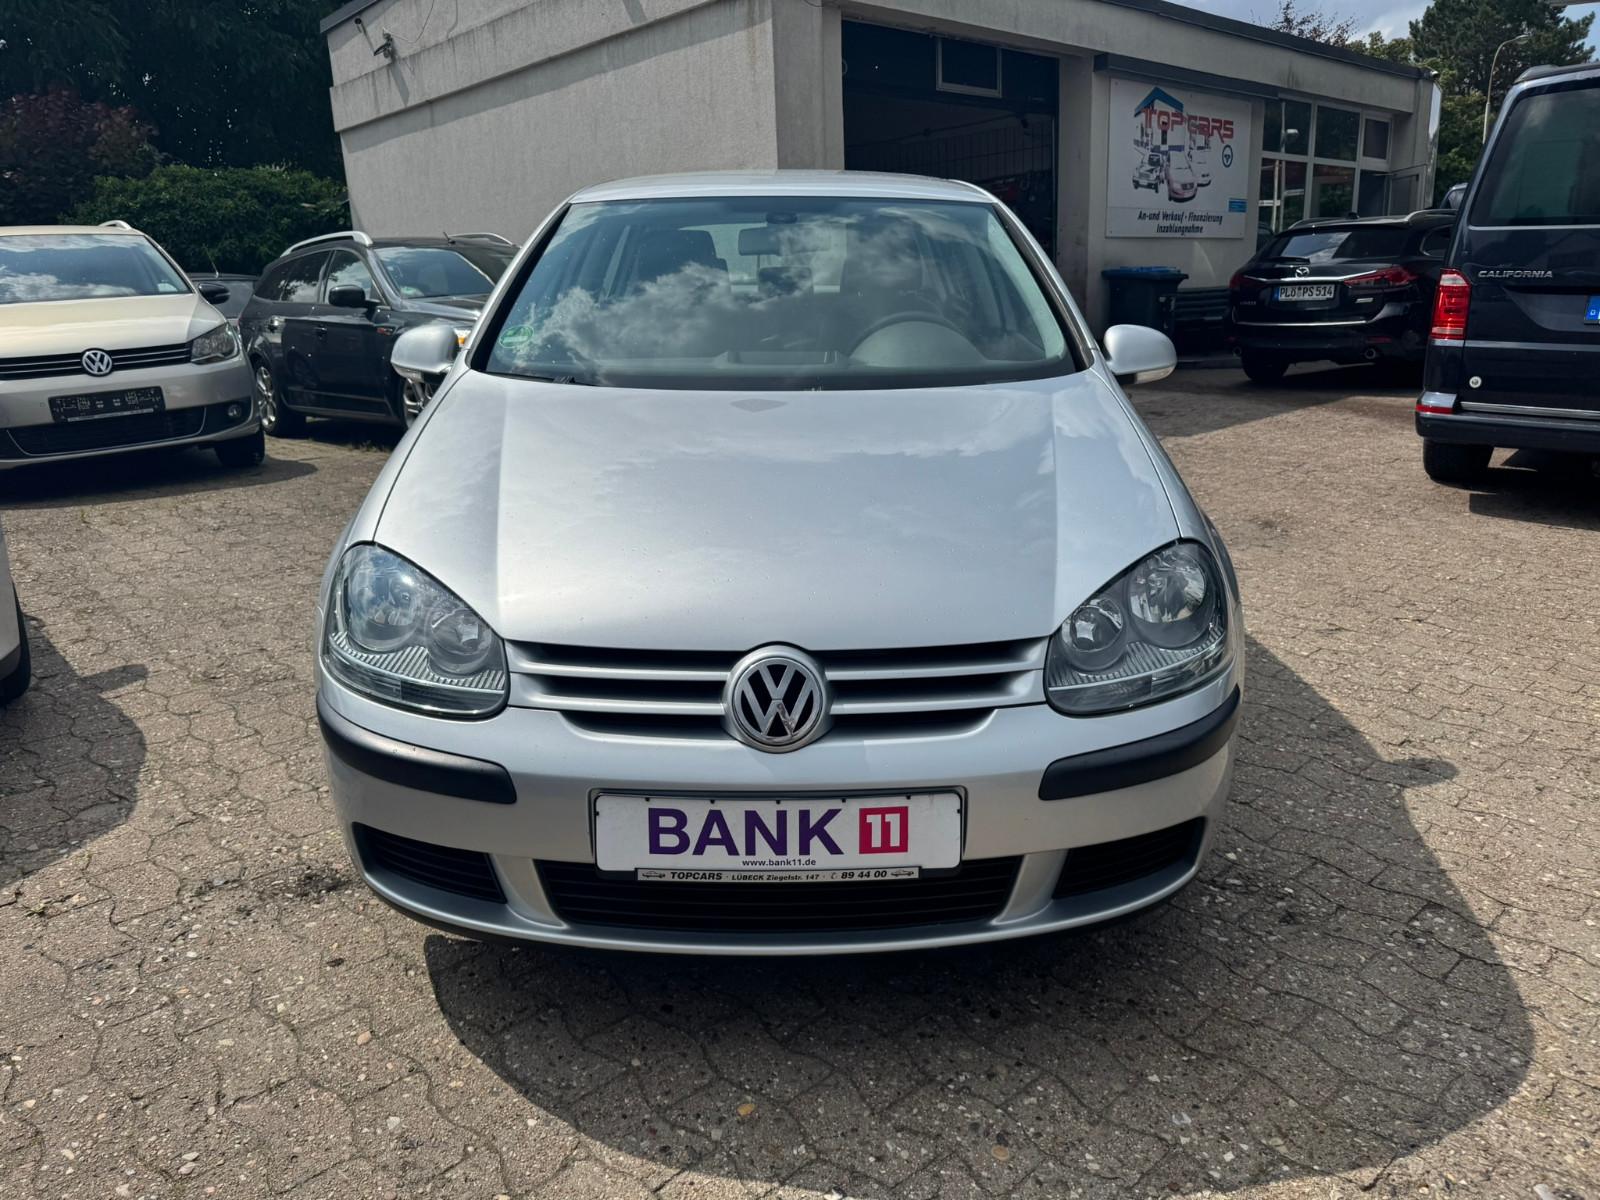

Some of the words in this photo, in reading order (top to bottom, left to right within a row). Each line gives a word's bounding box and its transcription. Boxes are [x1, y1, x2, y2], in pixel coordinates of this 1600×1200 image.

[1141, 107, 1185, 131] TOP
[1162, 211, 1185, 224] Verkauf
[1188, 212, 1223, 225] Finanzierung
[1156, 223, 1203, 236] Inzahlungnahme
[1477, 270, 1553, 278] CALIFORNIA
[1302, 286, 1314, 297] PS
[1315, 286, 1333, 297] 514
[733, 657, 825, 746] VW
[648, 807, 845, 856] BANK
[865, 811, 902, 849] 11
[741, 857, 817, 868] www.bank11.de
[670, 871, 723, 881] TOPCARS
[731, 873, 764, 882] LÜBECK
[805, 873, 820, 881] 147
[841, 871, 855, 880] 89
[857, 871, 871, 879] 44
[874, 870, 888, 879] 00
